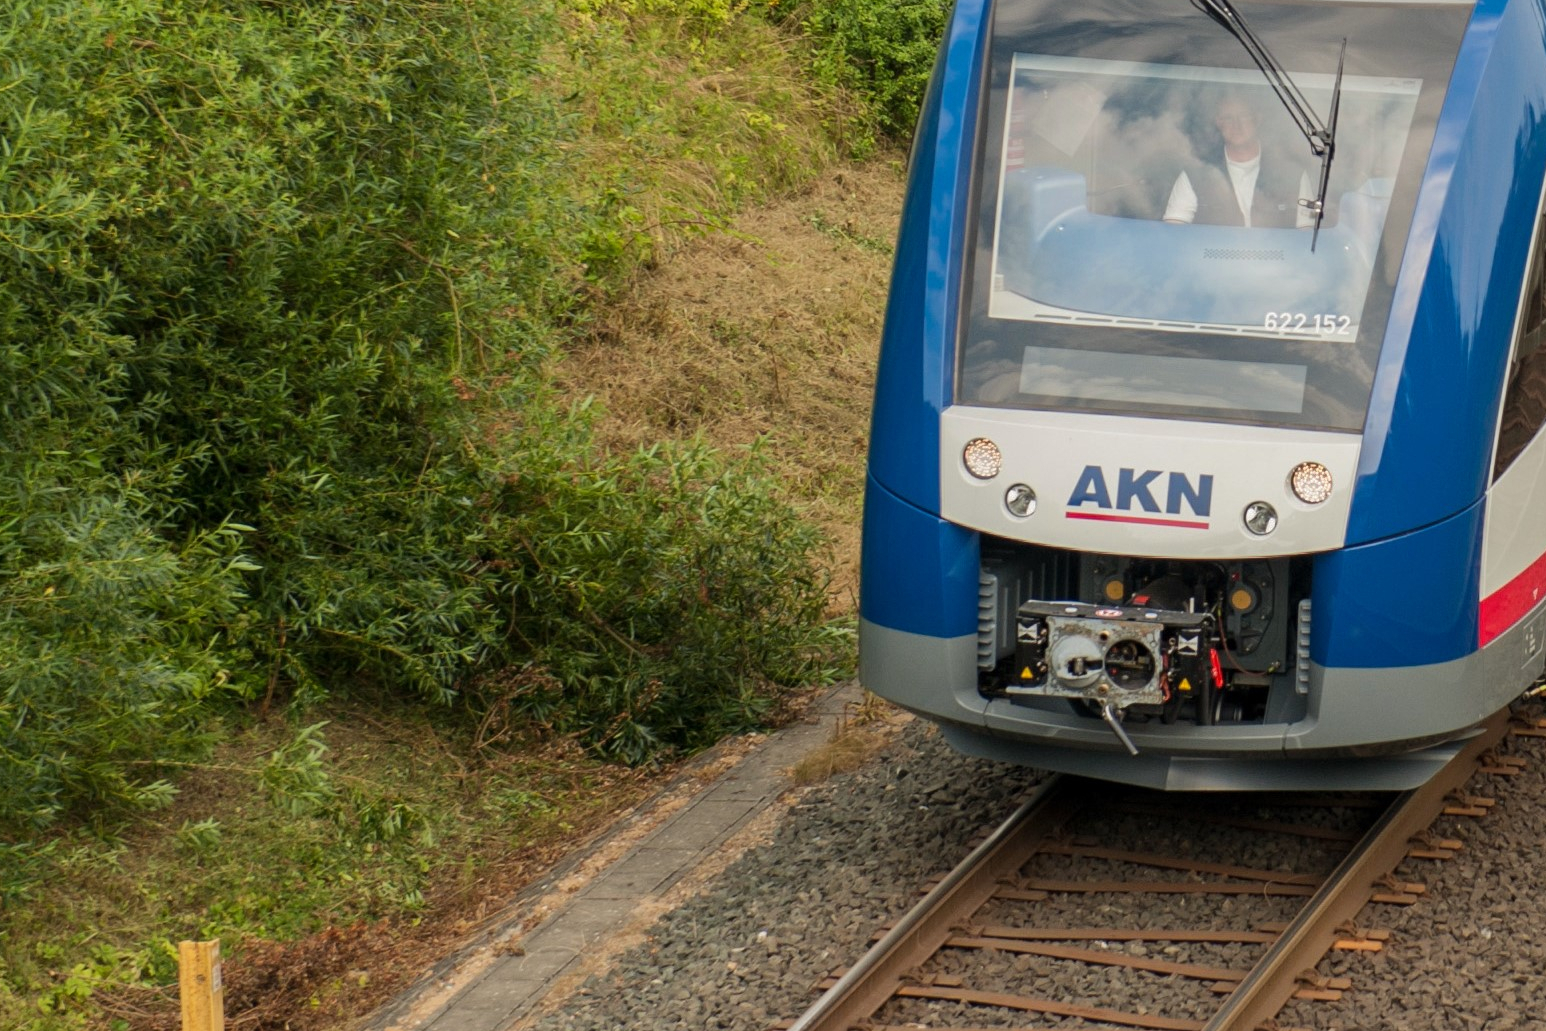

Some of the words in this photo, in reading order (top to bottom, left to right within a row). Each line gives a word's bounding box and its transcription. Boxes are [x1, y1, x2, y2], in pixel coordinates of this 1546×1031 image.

[1264, 311, 1307, 333] 622
[1313, 314, 1351, 335] 152
[1066, 465, 1213, 517] AKN
